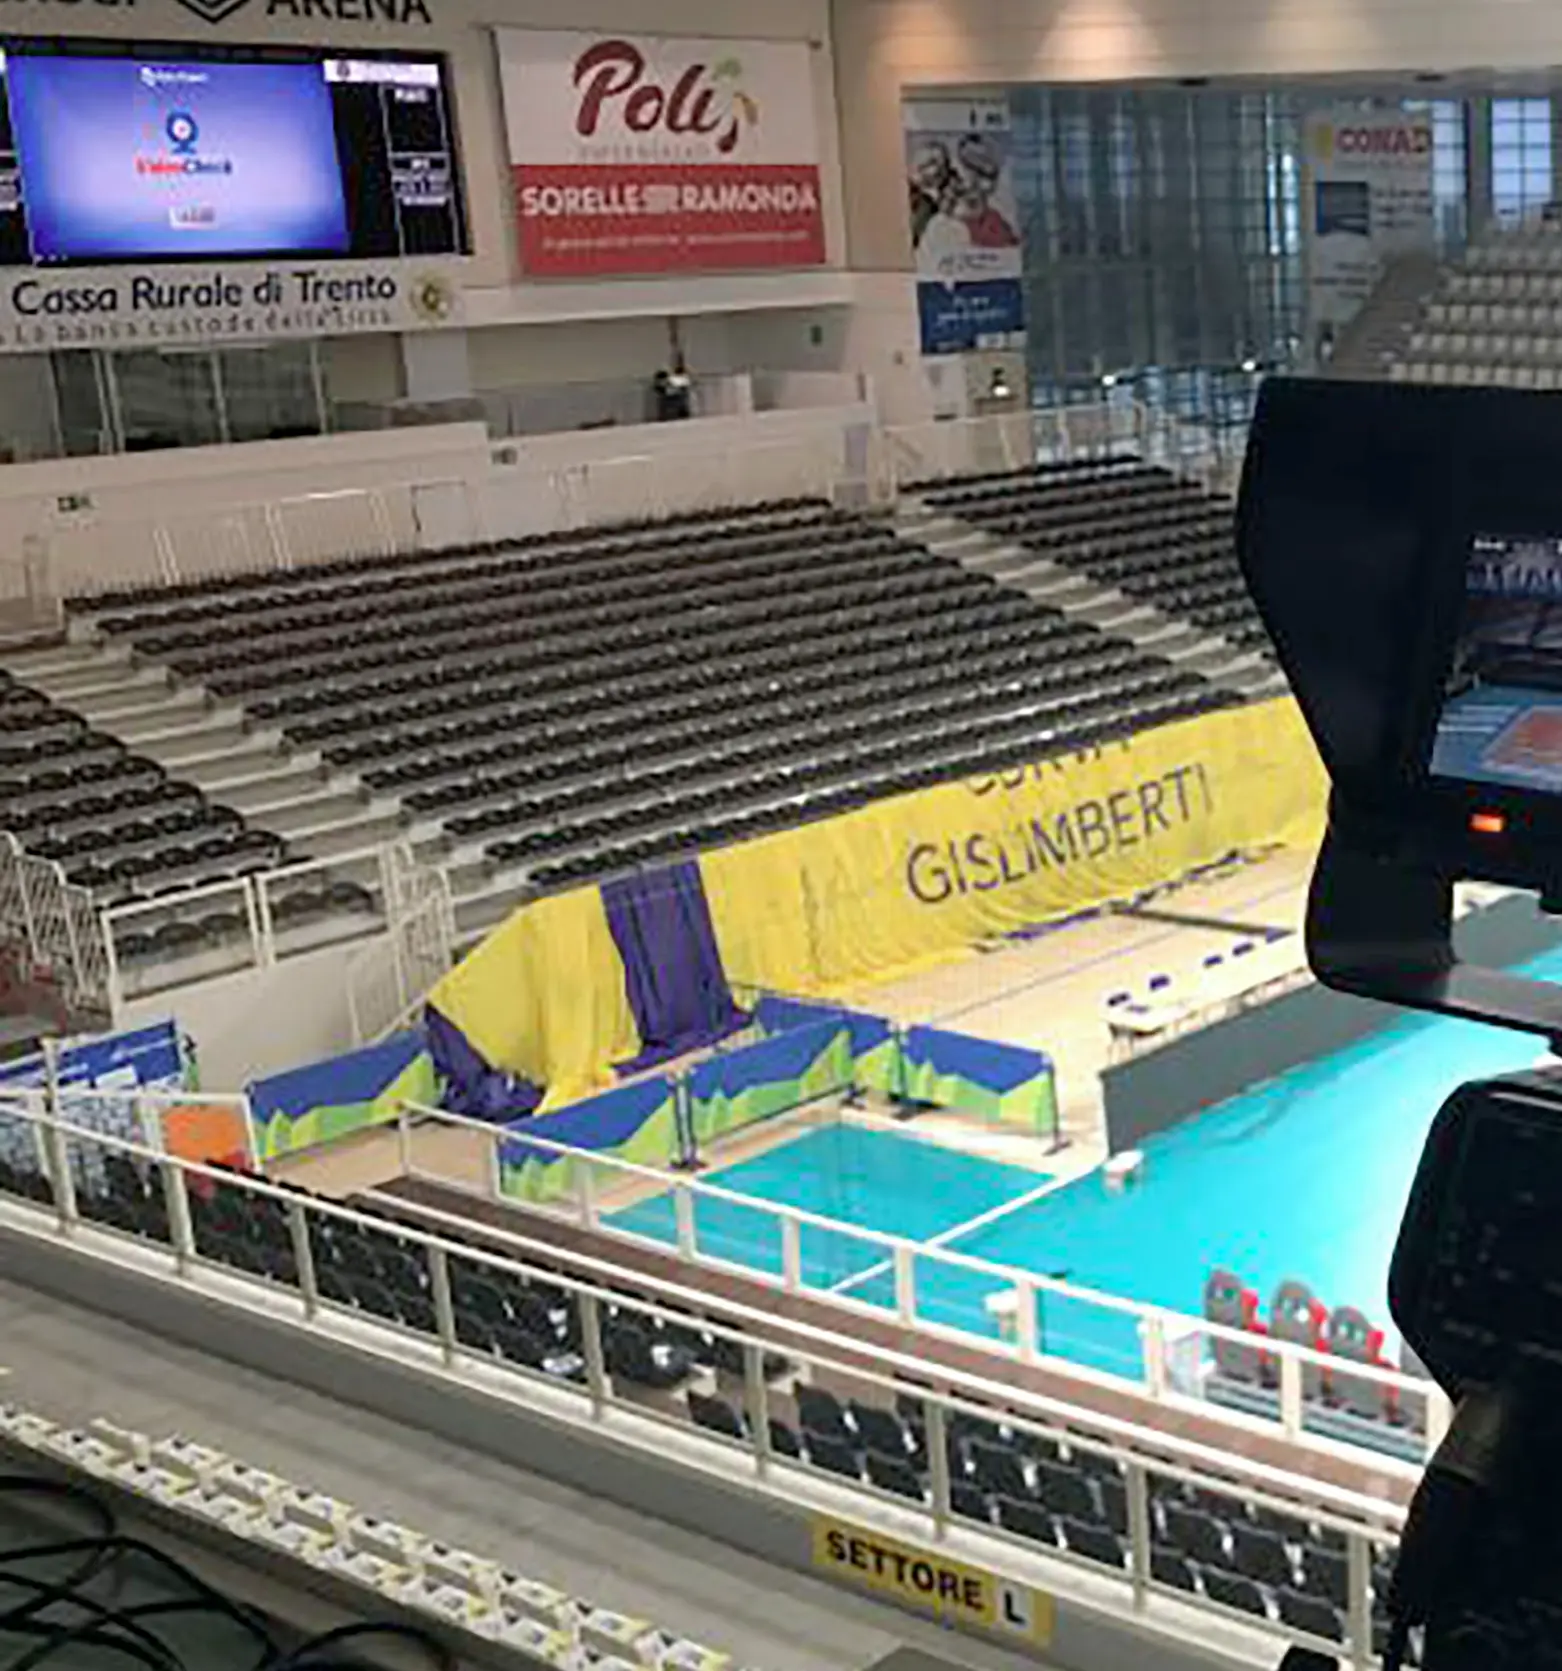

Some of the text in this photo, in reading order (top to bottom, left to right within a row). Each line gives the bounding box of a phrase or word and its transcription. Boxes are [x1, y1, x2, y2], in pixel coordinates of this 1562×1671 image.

[266, 0, 432, 24] ARENA
[573, 40, 728, 138] Poli
[521, 186, 640, 216] SORELLE
[682, 184, 816, 214] RAMONDA
[12, 270, 397, 316] Cassa Rurale di Trento
[908, 762, 1215, 903] GISLIMBERTI
[827, 1530, 1026, 1627] SETTORE L
